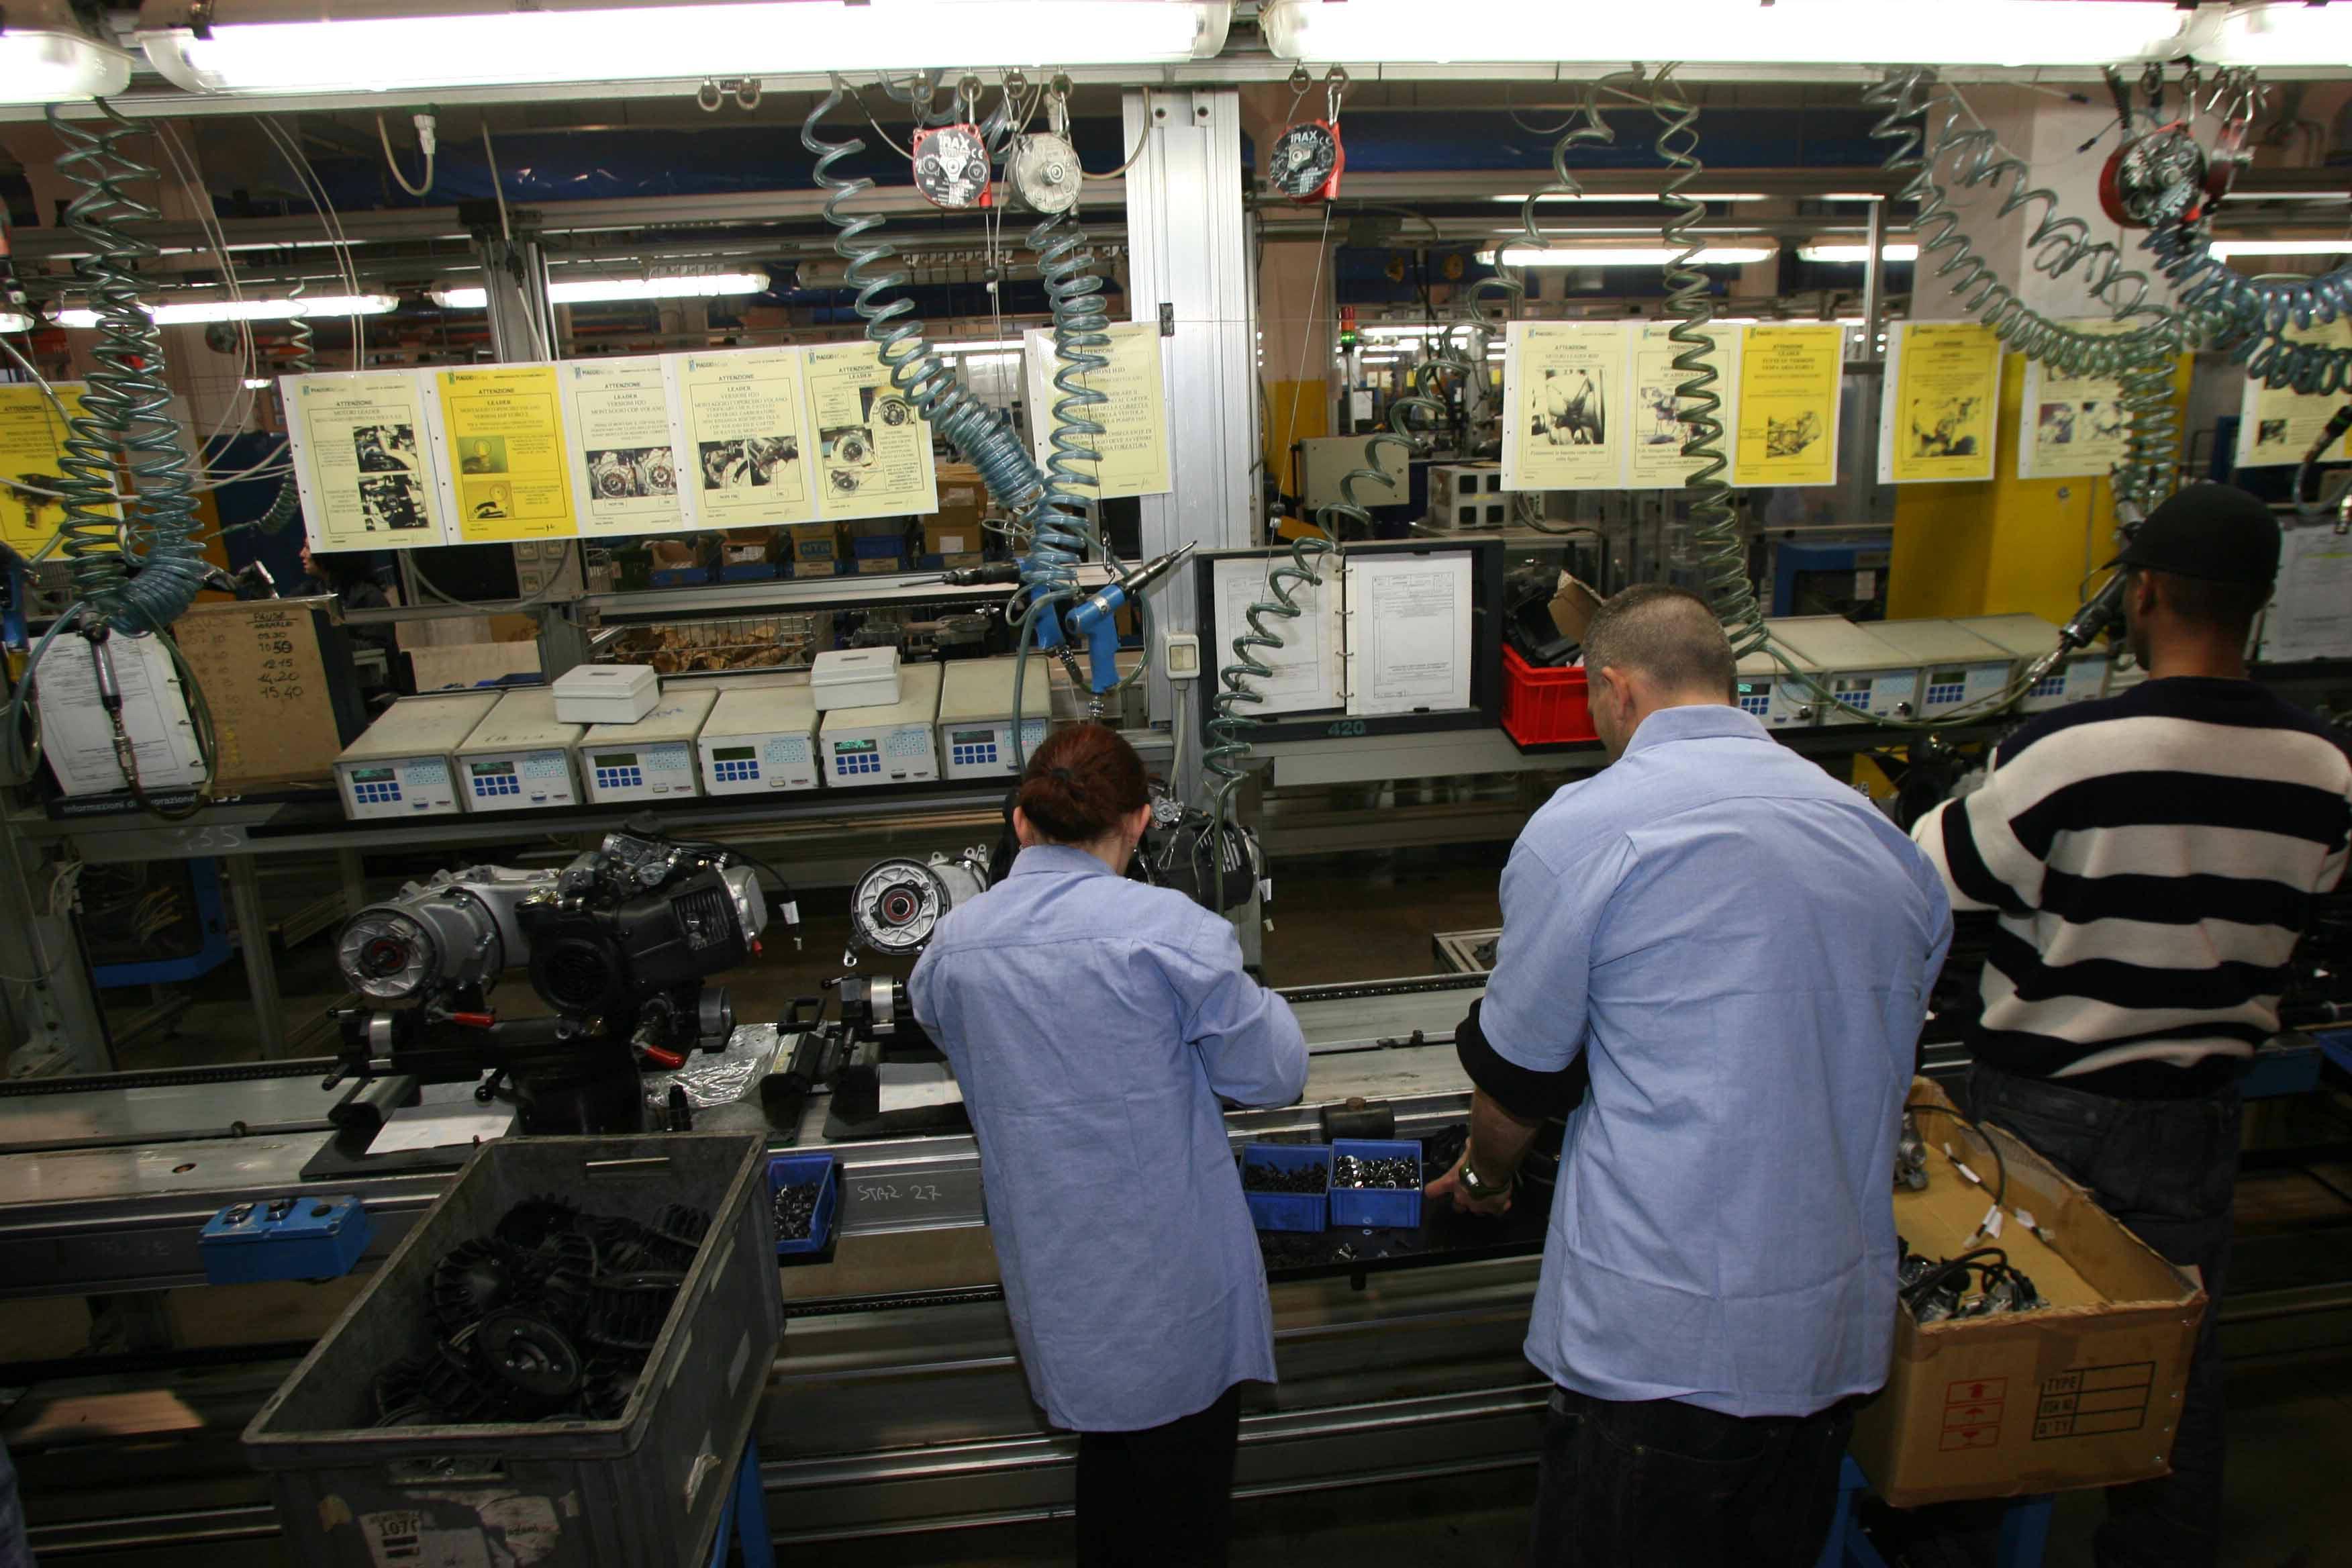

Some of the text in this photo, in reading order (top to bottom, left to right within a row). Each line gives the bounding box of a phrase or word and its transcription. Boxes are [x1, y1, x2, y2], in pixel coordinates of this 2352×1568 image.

[1327, 720, 1367, 736] 420
[910, 1185, 942, 1202] 27
[2047, 1375, 2077, 1390] TYPE
